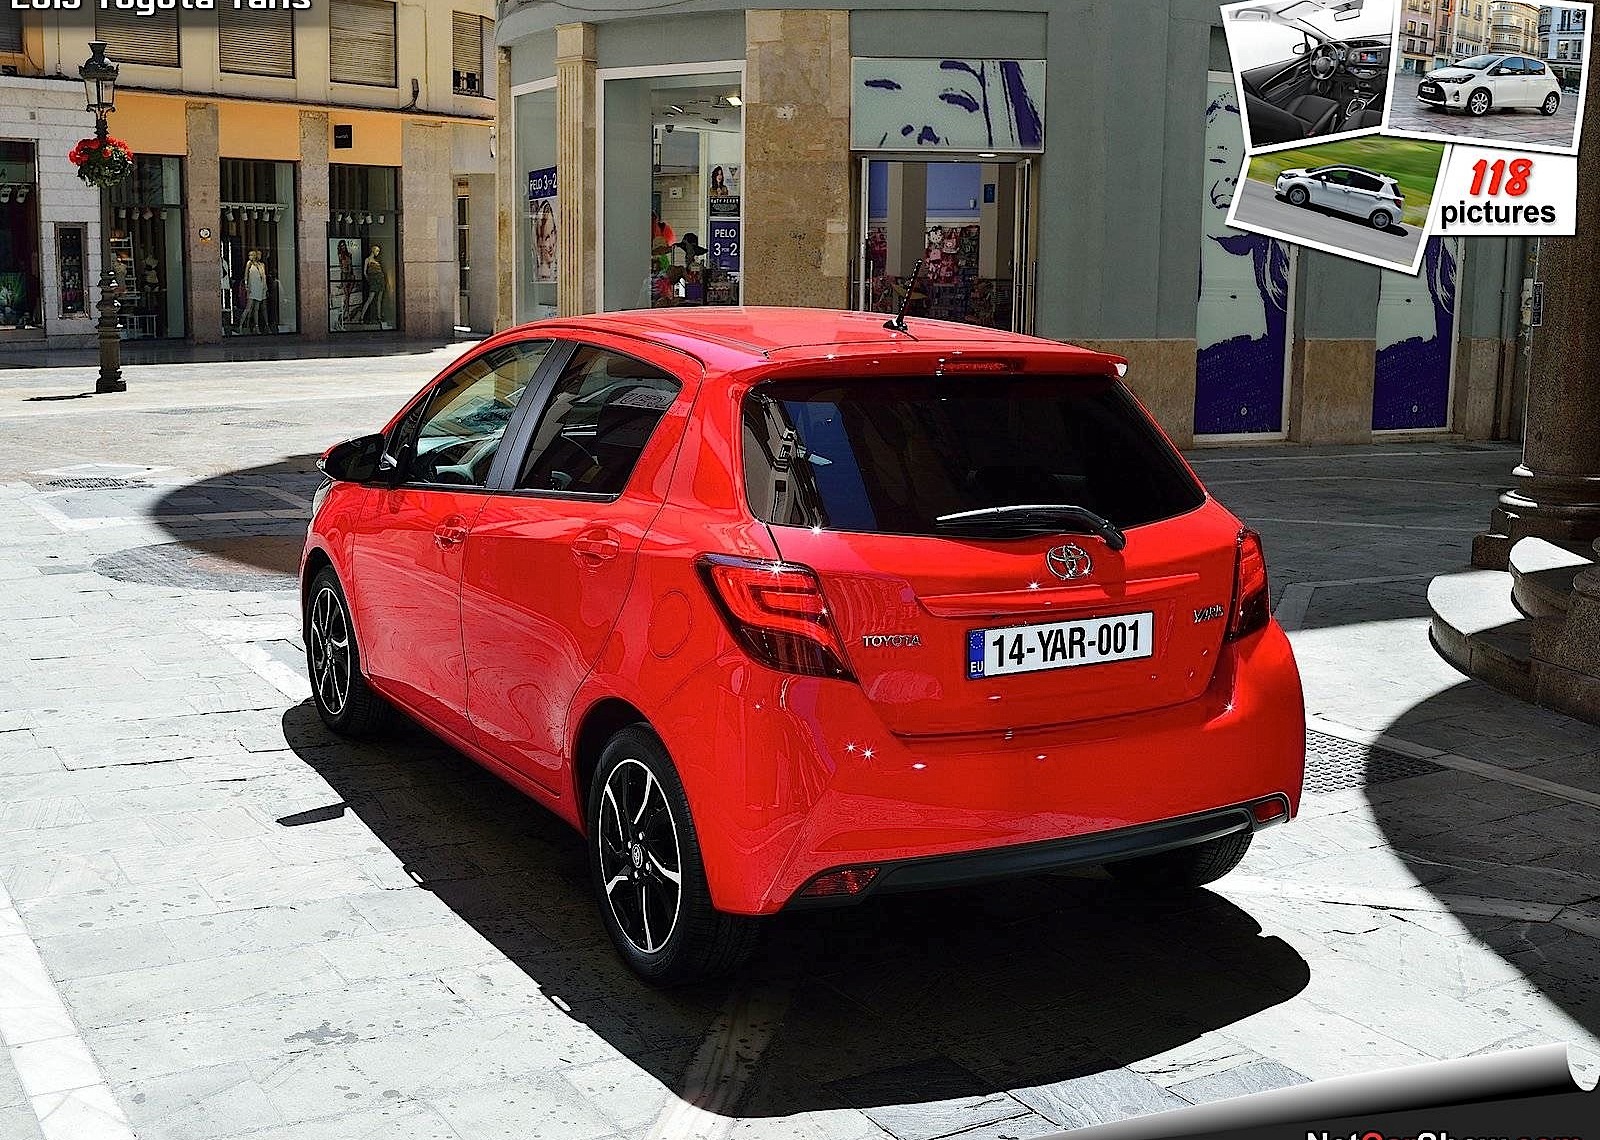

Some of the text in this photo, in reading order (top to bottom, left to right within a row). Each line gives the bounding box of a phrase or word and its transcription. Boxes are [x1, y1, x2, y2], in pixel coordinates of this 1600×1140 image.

[714, 228, 737, 238] PELO
[713, 242, 721, 256] 3
[730, 242, 738, 256] 2
[862, 634, 922, 647] TOYOTA
[992, 619, 1140, 668] 14-YAR-001
[970, 661, 984, 673] EU
